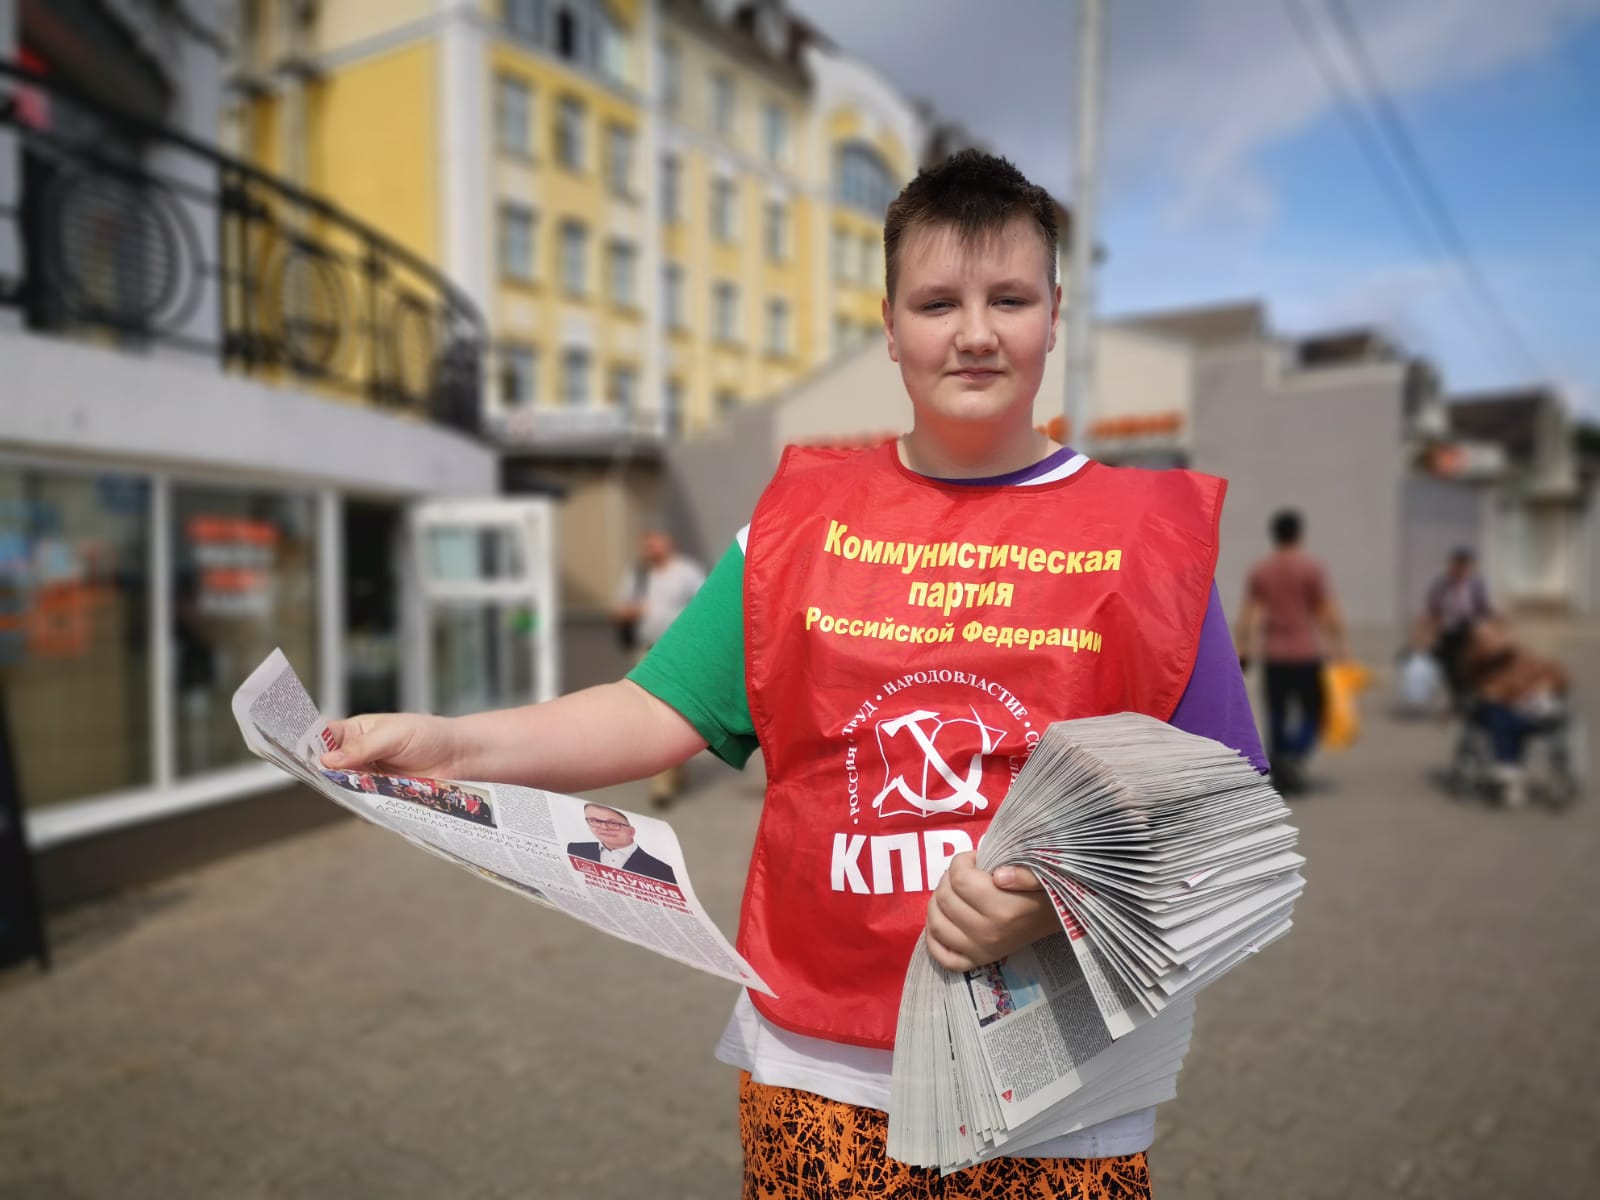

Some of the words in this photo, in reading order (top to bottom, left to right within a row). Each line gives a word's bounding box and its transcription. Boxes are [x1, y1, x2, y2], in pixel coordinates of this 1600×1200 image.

[823, 519, 1122, 574] Коммунистическая
[908, 580, 1015, 617] партия
[805, 606, 955, 644] Российской
[961, 620, 1103, 653] Федерации
[841, 699, 879, 737] ТРУД
[881, 669, 1029, 721] НАРОДОВЛАСТИЕ
[845, 746, 860, 816] РОССИЯ
[601, 869, 682, 900] НАУМОВ
[831, 829, 986, 895] КПР
